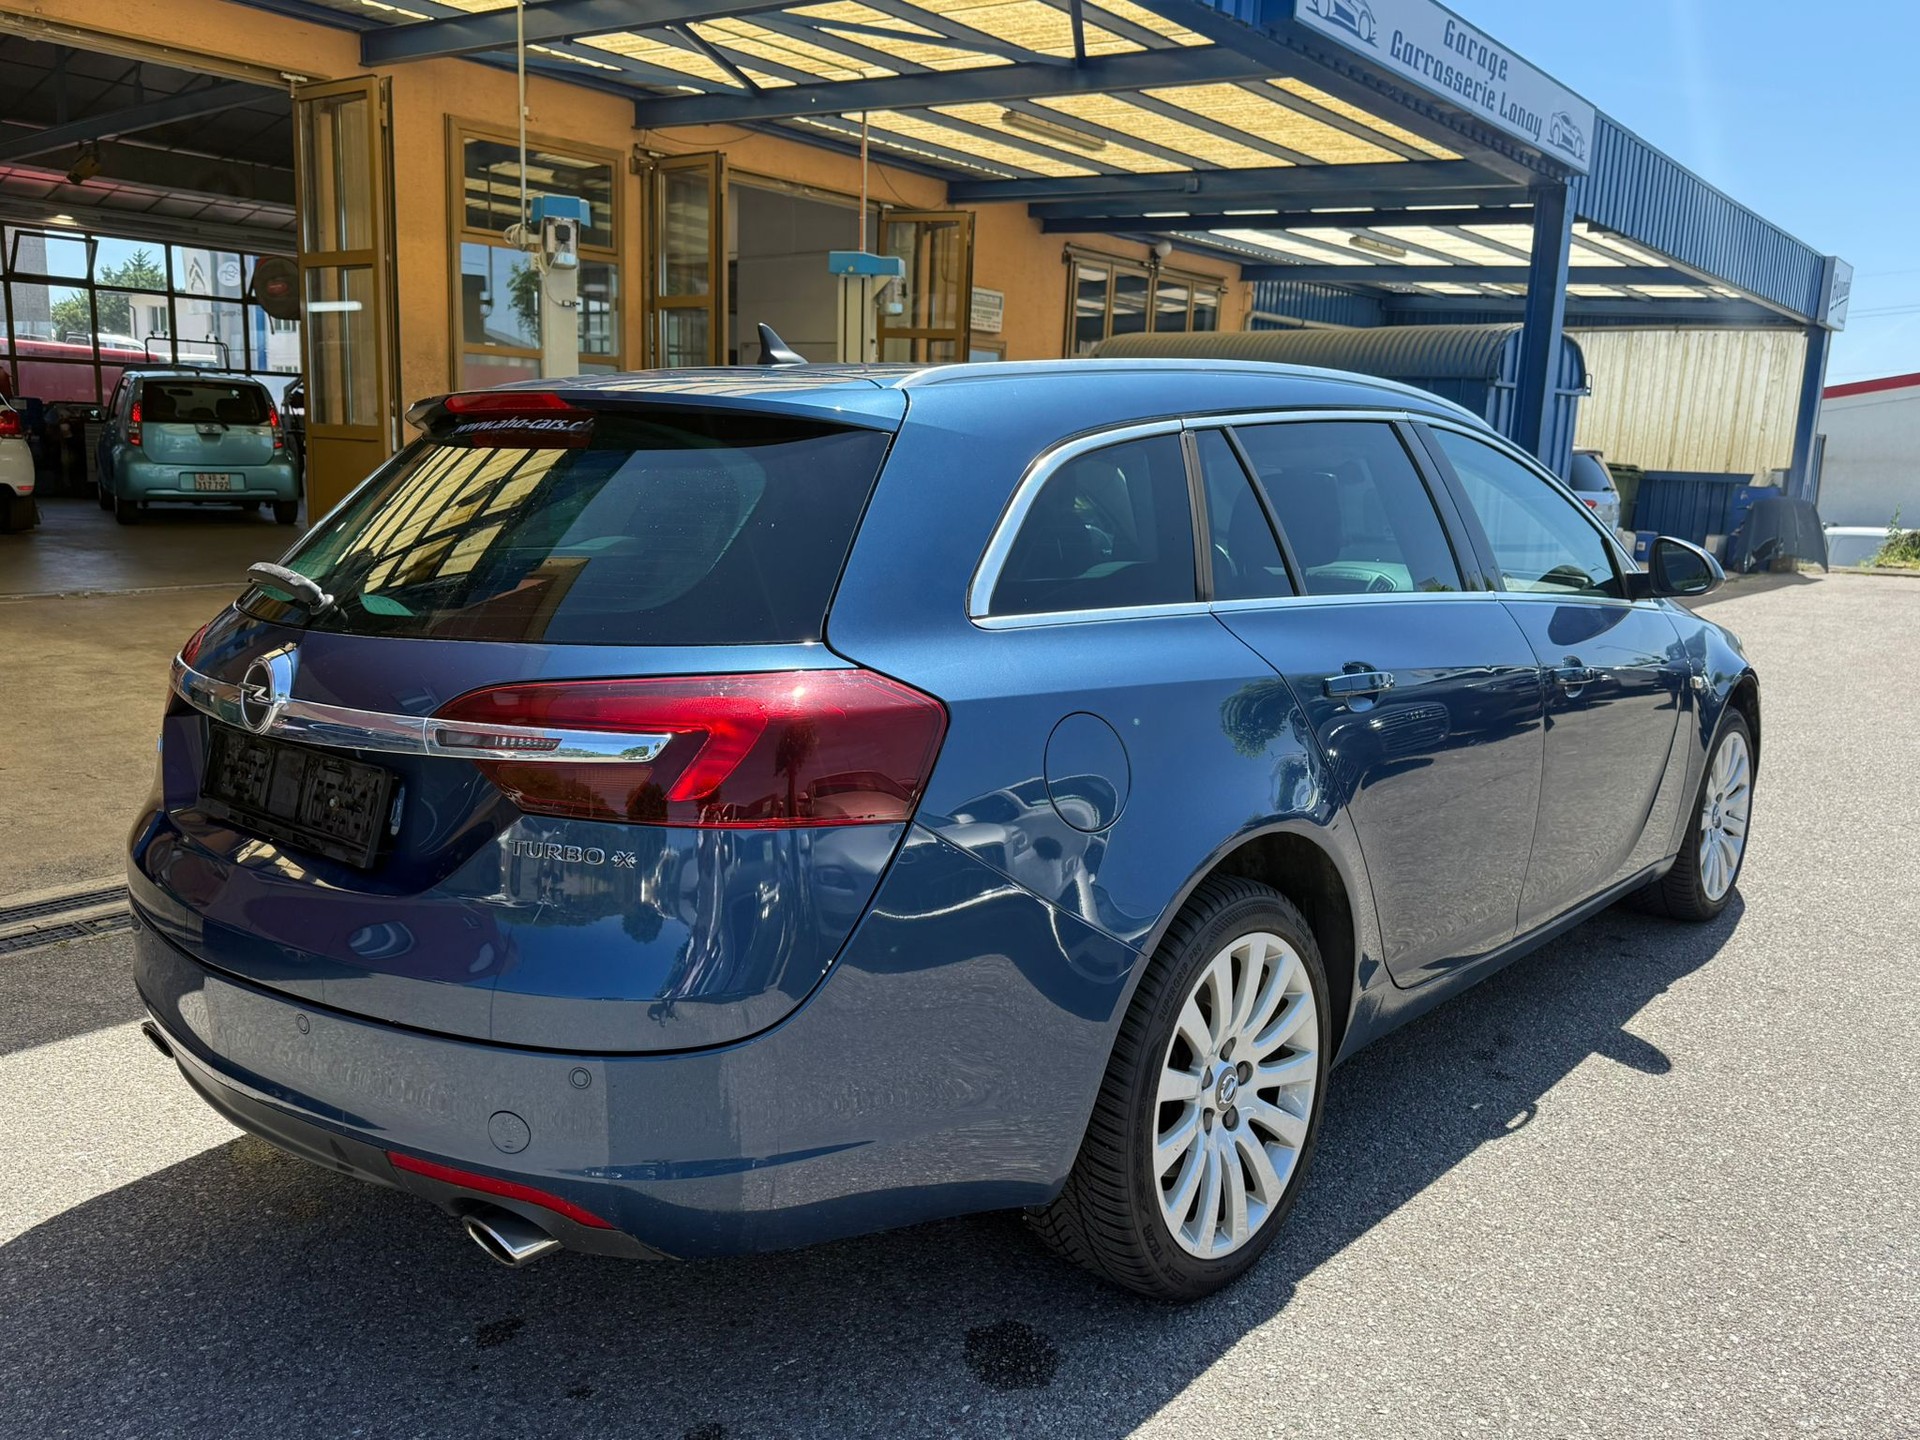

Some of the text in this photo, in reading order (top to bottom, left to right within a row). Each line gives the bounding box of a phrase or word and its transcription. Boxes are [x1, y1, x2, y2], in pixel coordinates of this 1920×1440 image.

[1390, 29, 1543, 142] Carrosserie Lonay
[1443, 19, 1509, 82] Garage
[509, 839, 606, 866] TURBO
[1158, 943, 1203, 1023] SUPERGRIP PRO
